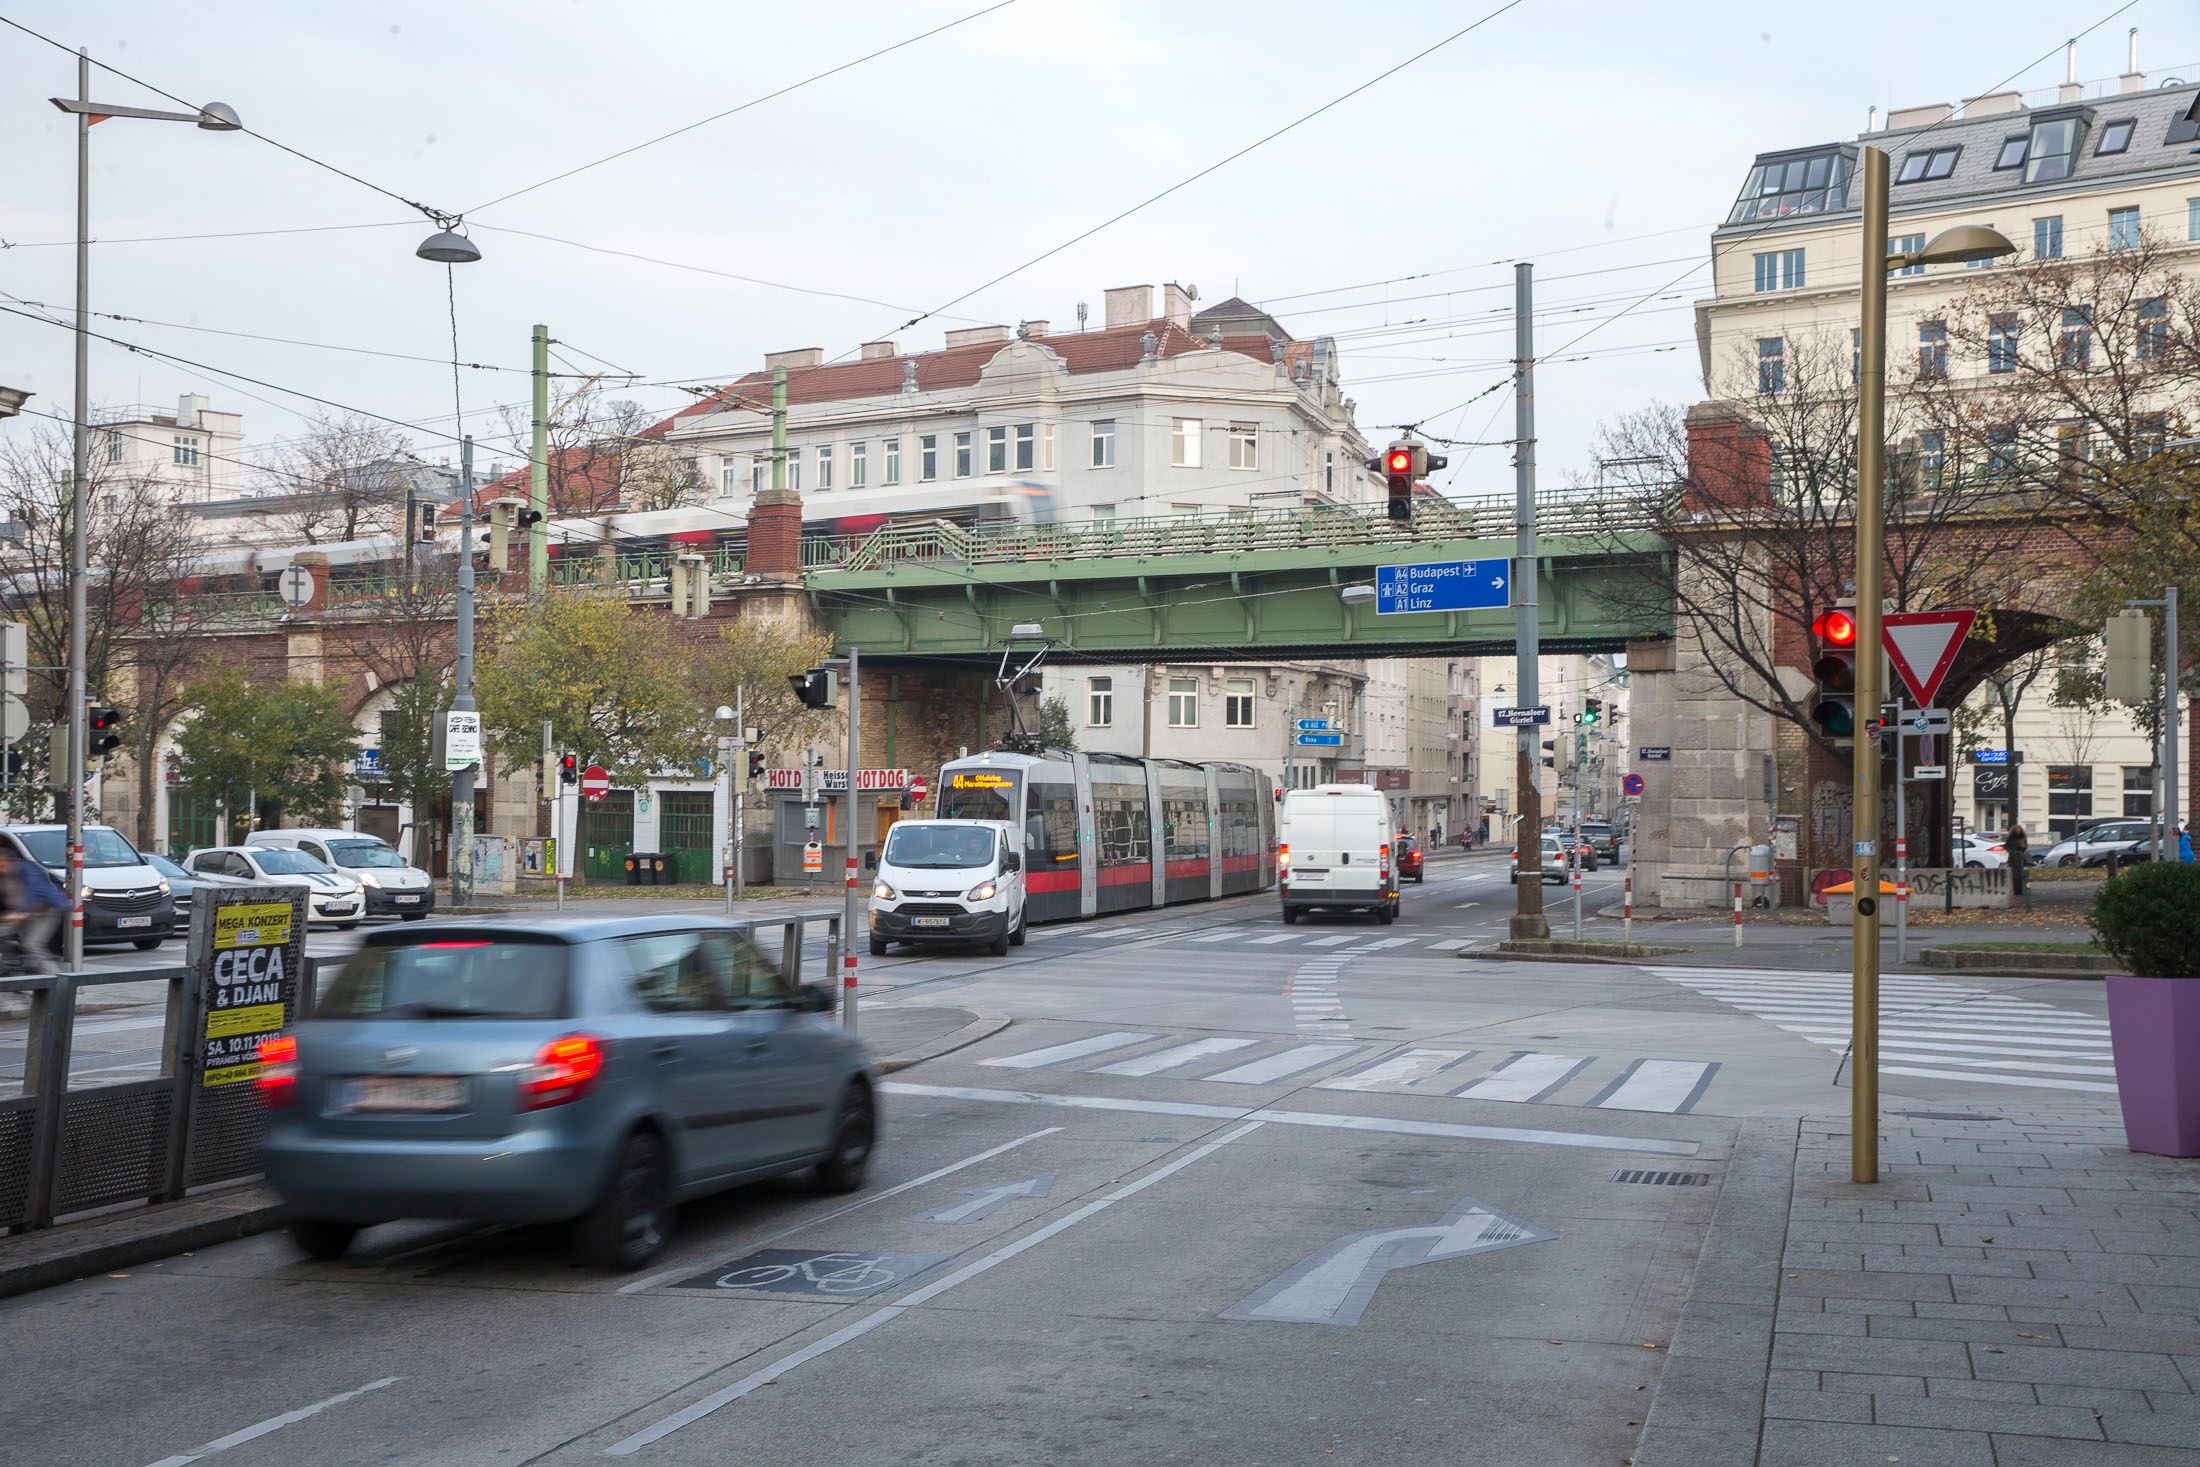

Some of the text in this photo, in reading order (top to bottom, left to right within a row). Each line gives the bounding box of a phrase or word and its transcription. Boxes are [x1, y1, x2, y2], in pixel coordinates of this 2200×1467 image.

[1396, 565, 1460, 580] A4 Budapest
[1396, 582, 1434, 594] A2 Graz
[1396, 597, 1432, 609] A1 Linz
[769, 769, 792, 787] HOT
[879, 769, 904, 788] DOG
[953, 774, 964, 789] 44
[218, 913, 290, 930] MEGA KONZERT
[214, 946, 284, 987] CECA
[216, 982, 279, 1008] & DJANI
